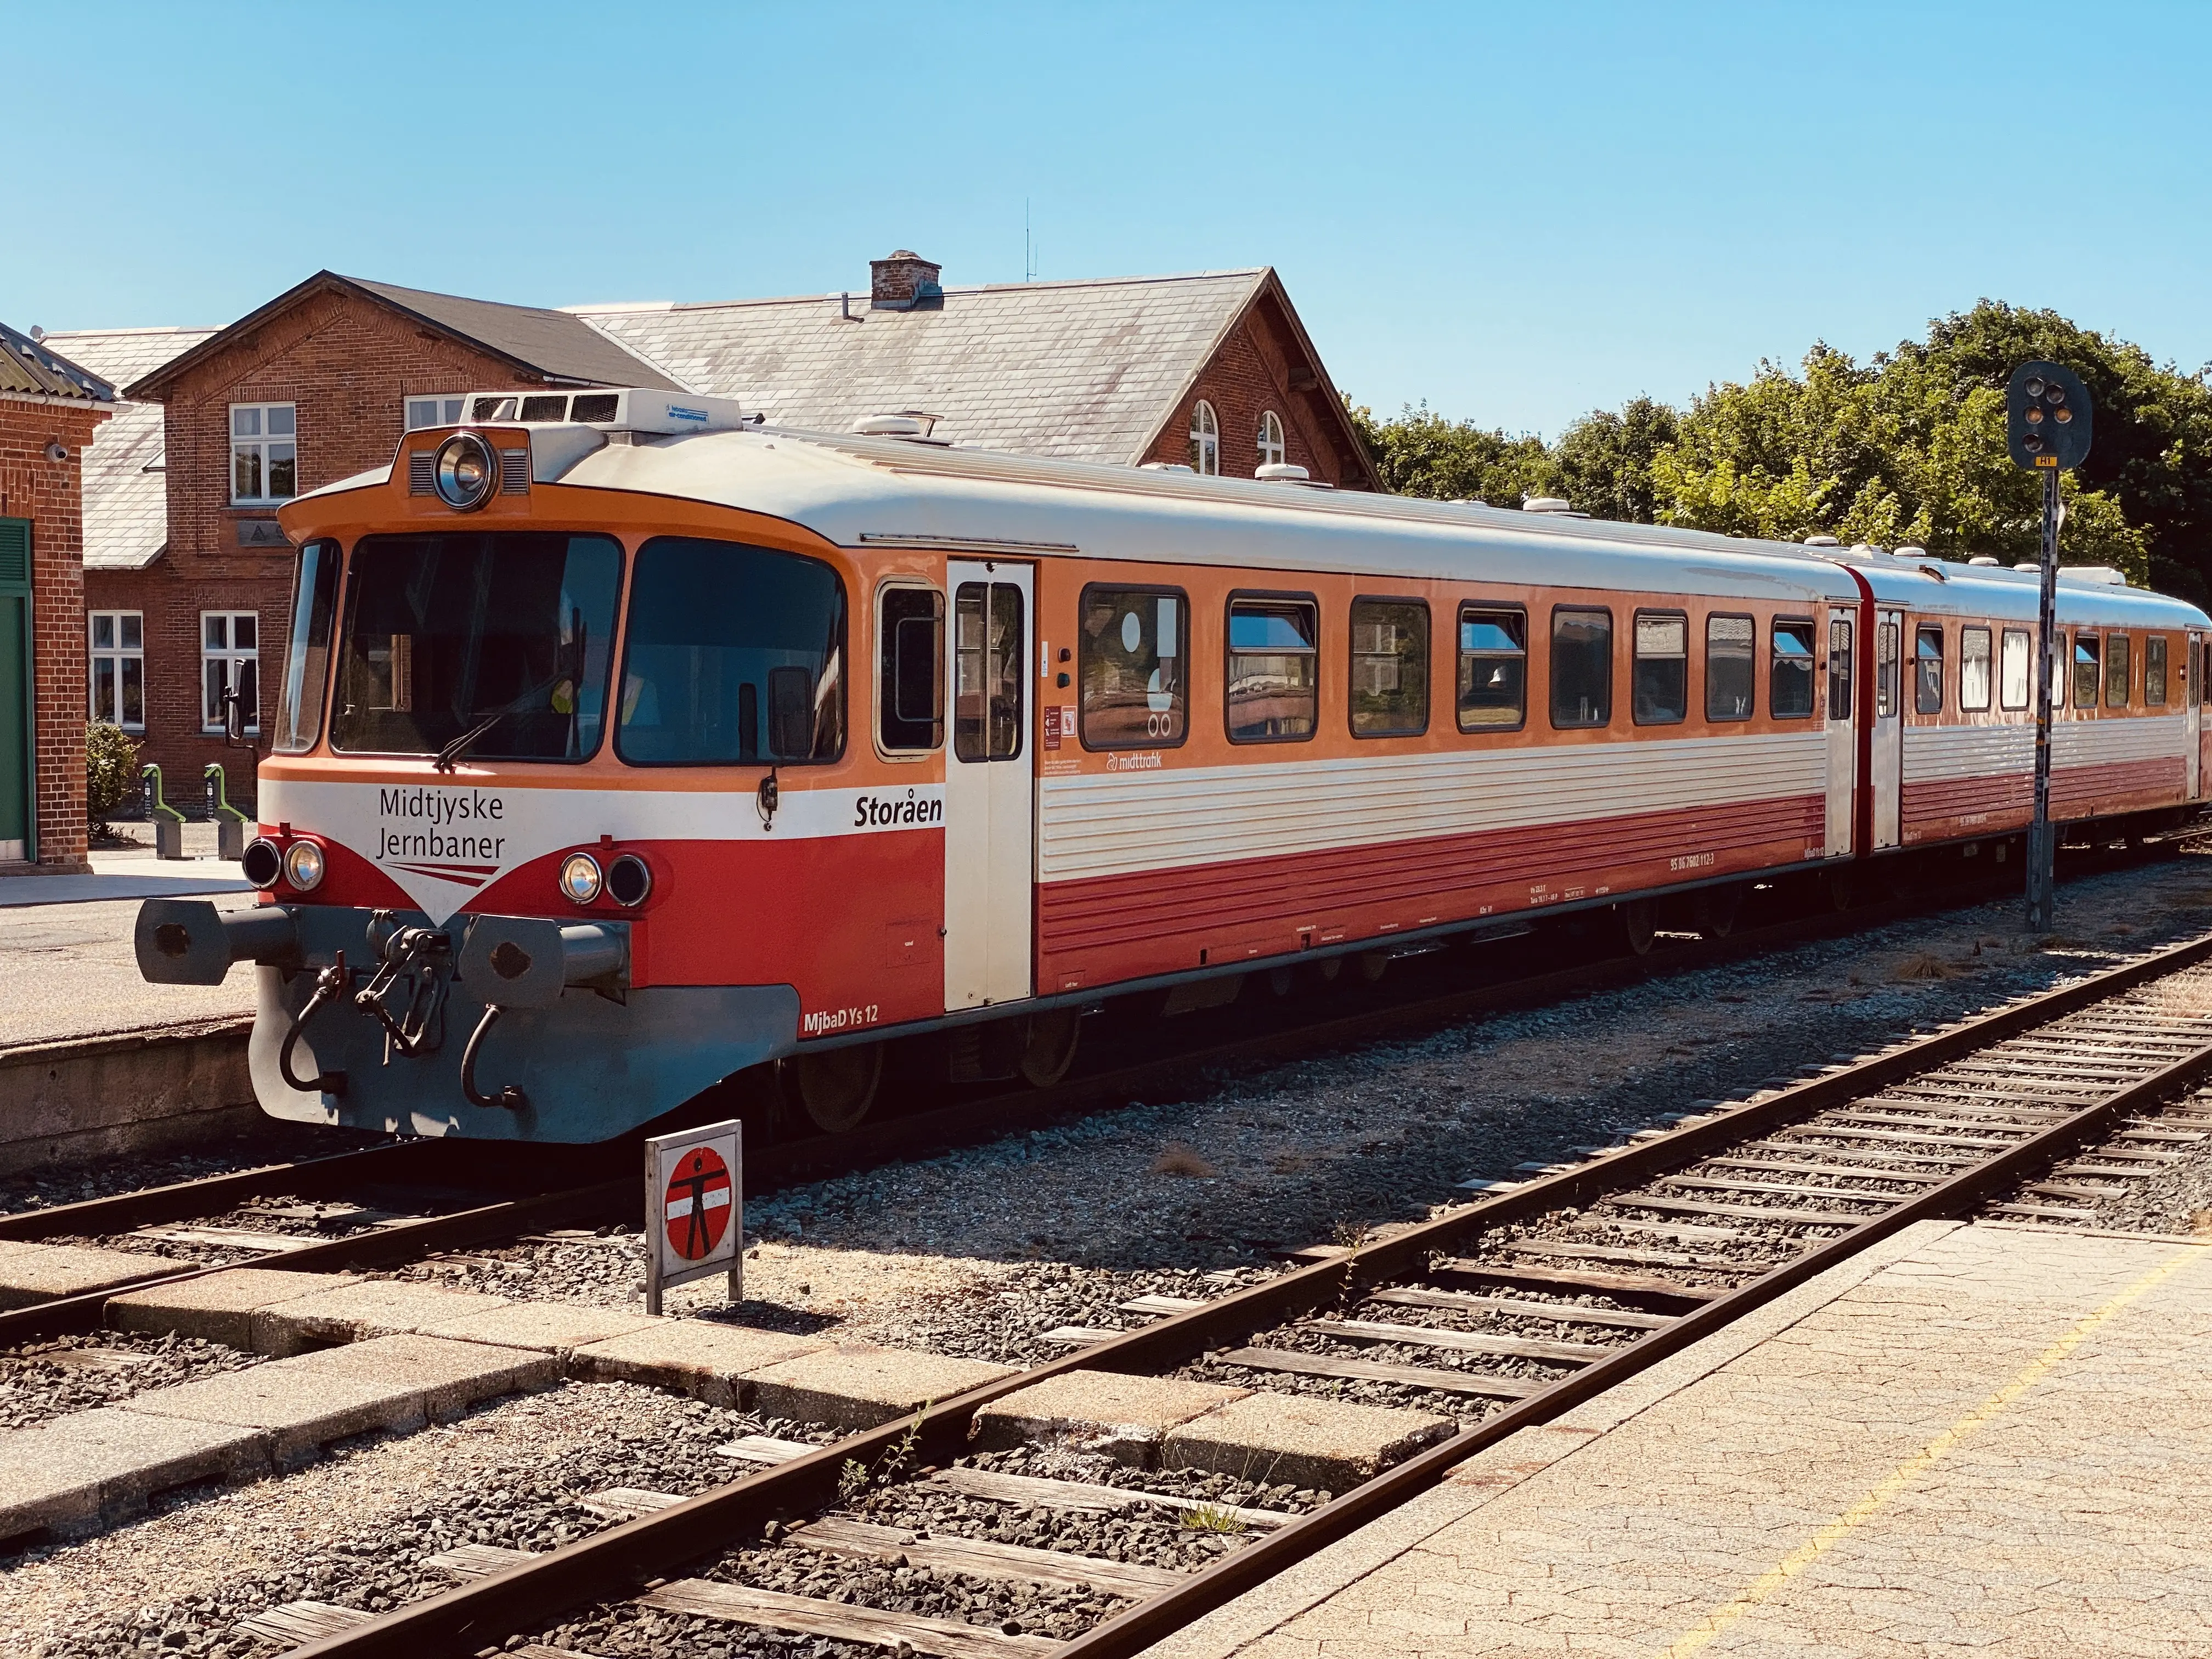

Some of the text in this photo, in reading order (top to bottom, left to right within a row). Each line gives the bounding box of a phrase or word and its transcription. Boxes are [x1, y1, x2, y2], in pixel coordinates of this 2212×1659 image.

[669, 412, 707, 422] air-conditioned
[2040, 456, 2050, 465] H1
[1119, 751, 1162, 770] midttrafik
[381, 788, 503, 825] Midtjyske
[854, 788, 943, 827] Storåen
[376, 827, 505, 859] Jernbaner
[1671, 853, 1714, 871] 95 86 7602 112-3
[804, 1005, 878, 1035] MjbaD Ys 12
